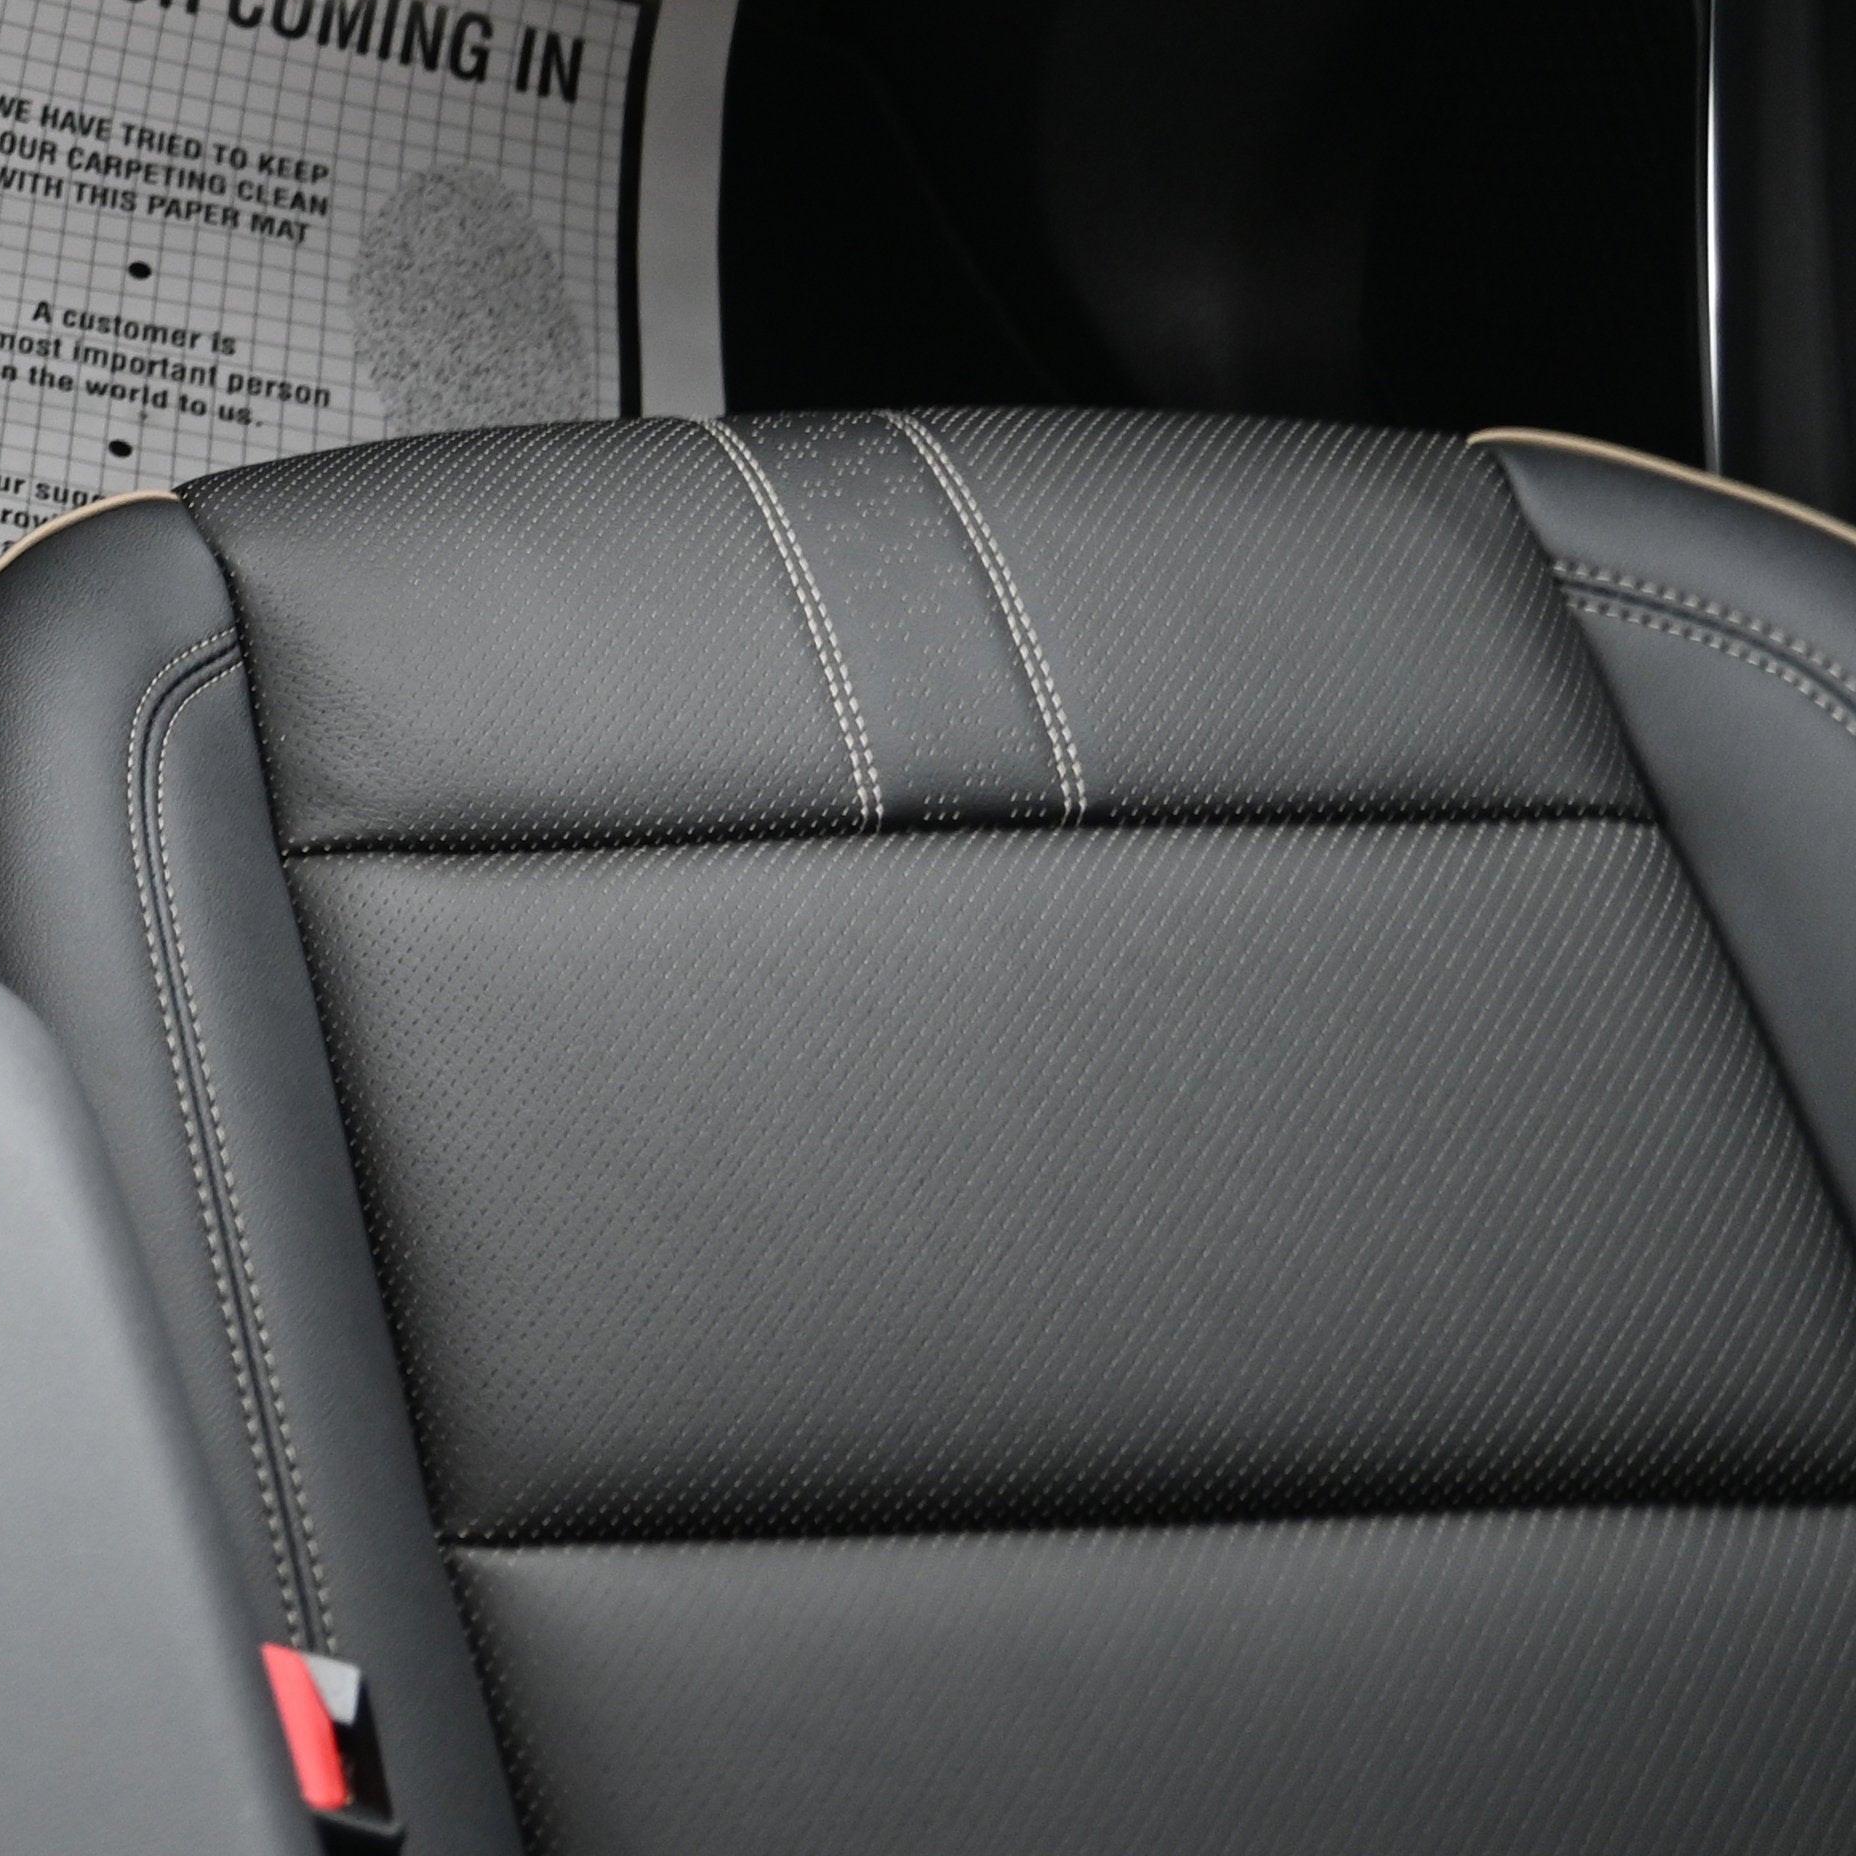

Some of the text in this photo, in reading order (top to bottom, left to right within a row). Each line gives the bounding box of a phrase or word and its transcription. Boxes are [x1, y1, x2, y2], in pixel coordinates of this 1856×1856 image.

[515, 26, 585, 104] IN
[40, 105, 113, 142] HAVE
[122, 123, 202, 160] TRIED
[214, 143, 248, 171] TO
[258, 153, 329, 184] KEEP
[67, 146, 226, 195] CARPETING
[238, 180, 328, 216] CLEAN
[75, 183, 137, 213] THIS
[147, 196, 239, 228] PAPER
[251, 213, 311, 244] MAT
[32, 301, 236, 356] A customer is
[28, 366, 74, 393] the
[85, 379, 168, 409] world
[179, 395, 207, 416] to
[218, 405, 264, 426] us.
[73, 339, 217, 388] important
[226, 371, 330, 408] person
